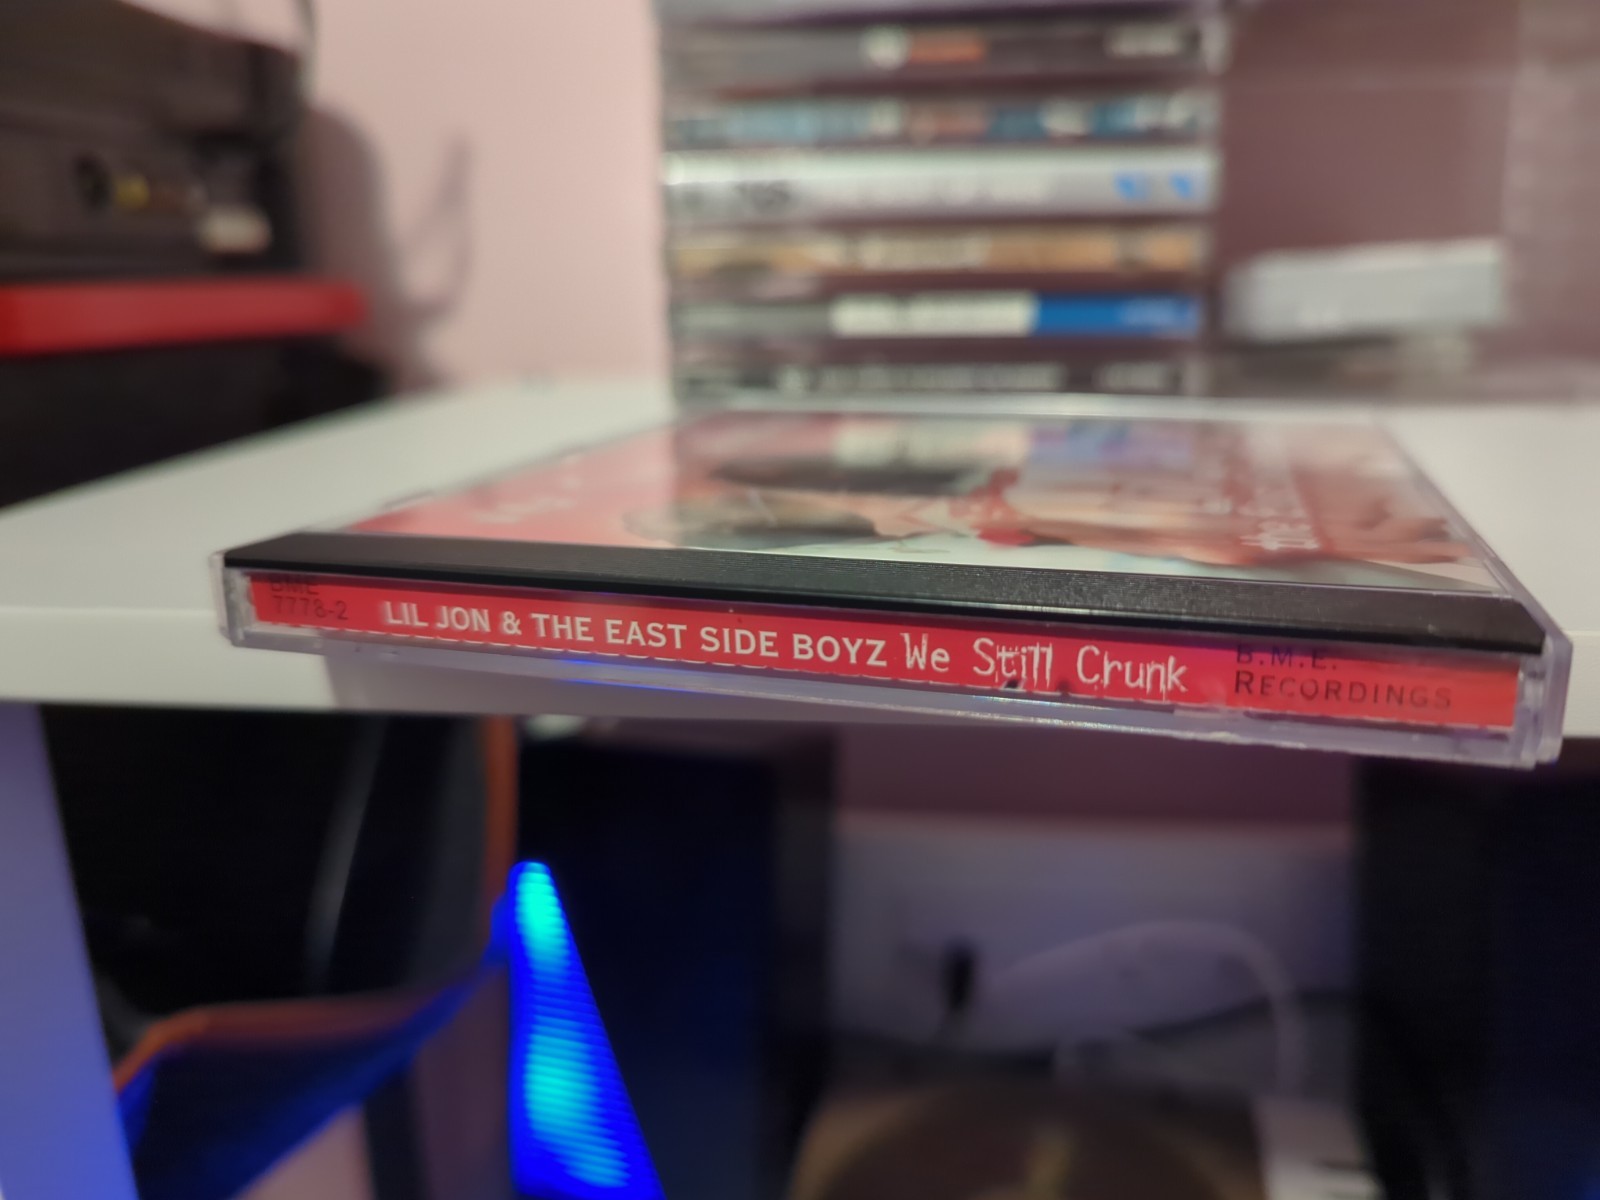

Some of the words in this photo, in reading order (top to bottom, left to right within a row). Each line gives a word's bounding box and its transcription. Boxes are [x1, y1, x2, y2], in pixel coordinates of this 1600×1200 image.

[385, 601, 429, 627] LIL
[436, 605, 491, 633] JON
[502, 611, 521, 635] &
[531, 612, 594, 642] THE
[605, 618, 687, 649] EAST
[700, 626, 779, 658] SIDE
[792, 633, 887, 668] BOYZ
[900, 633, 950, 672] We
[973, 637, 1053, 688] Still
[1077, 645, 1189, 702] Crunk
[1234, 670, 1452, 711] RECORDINGS
